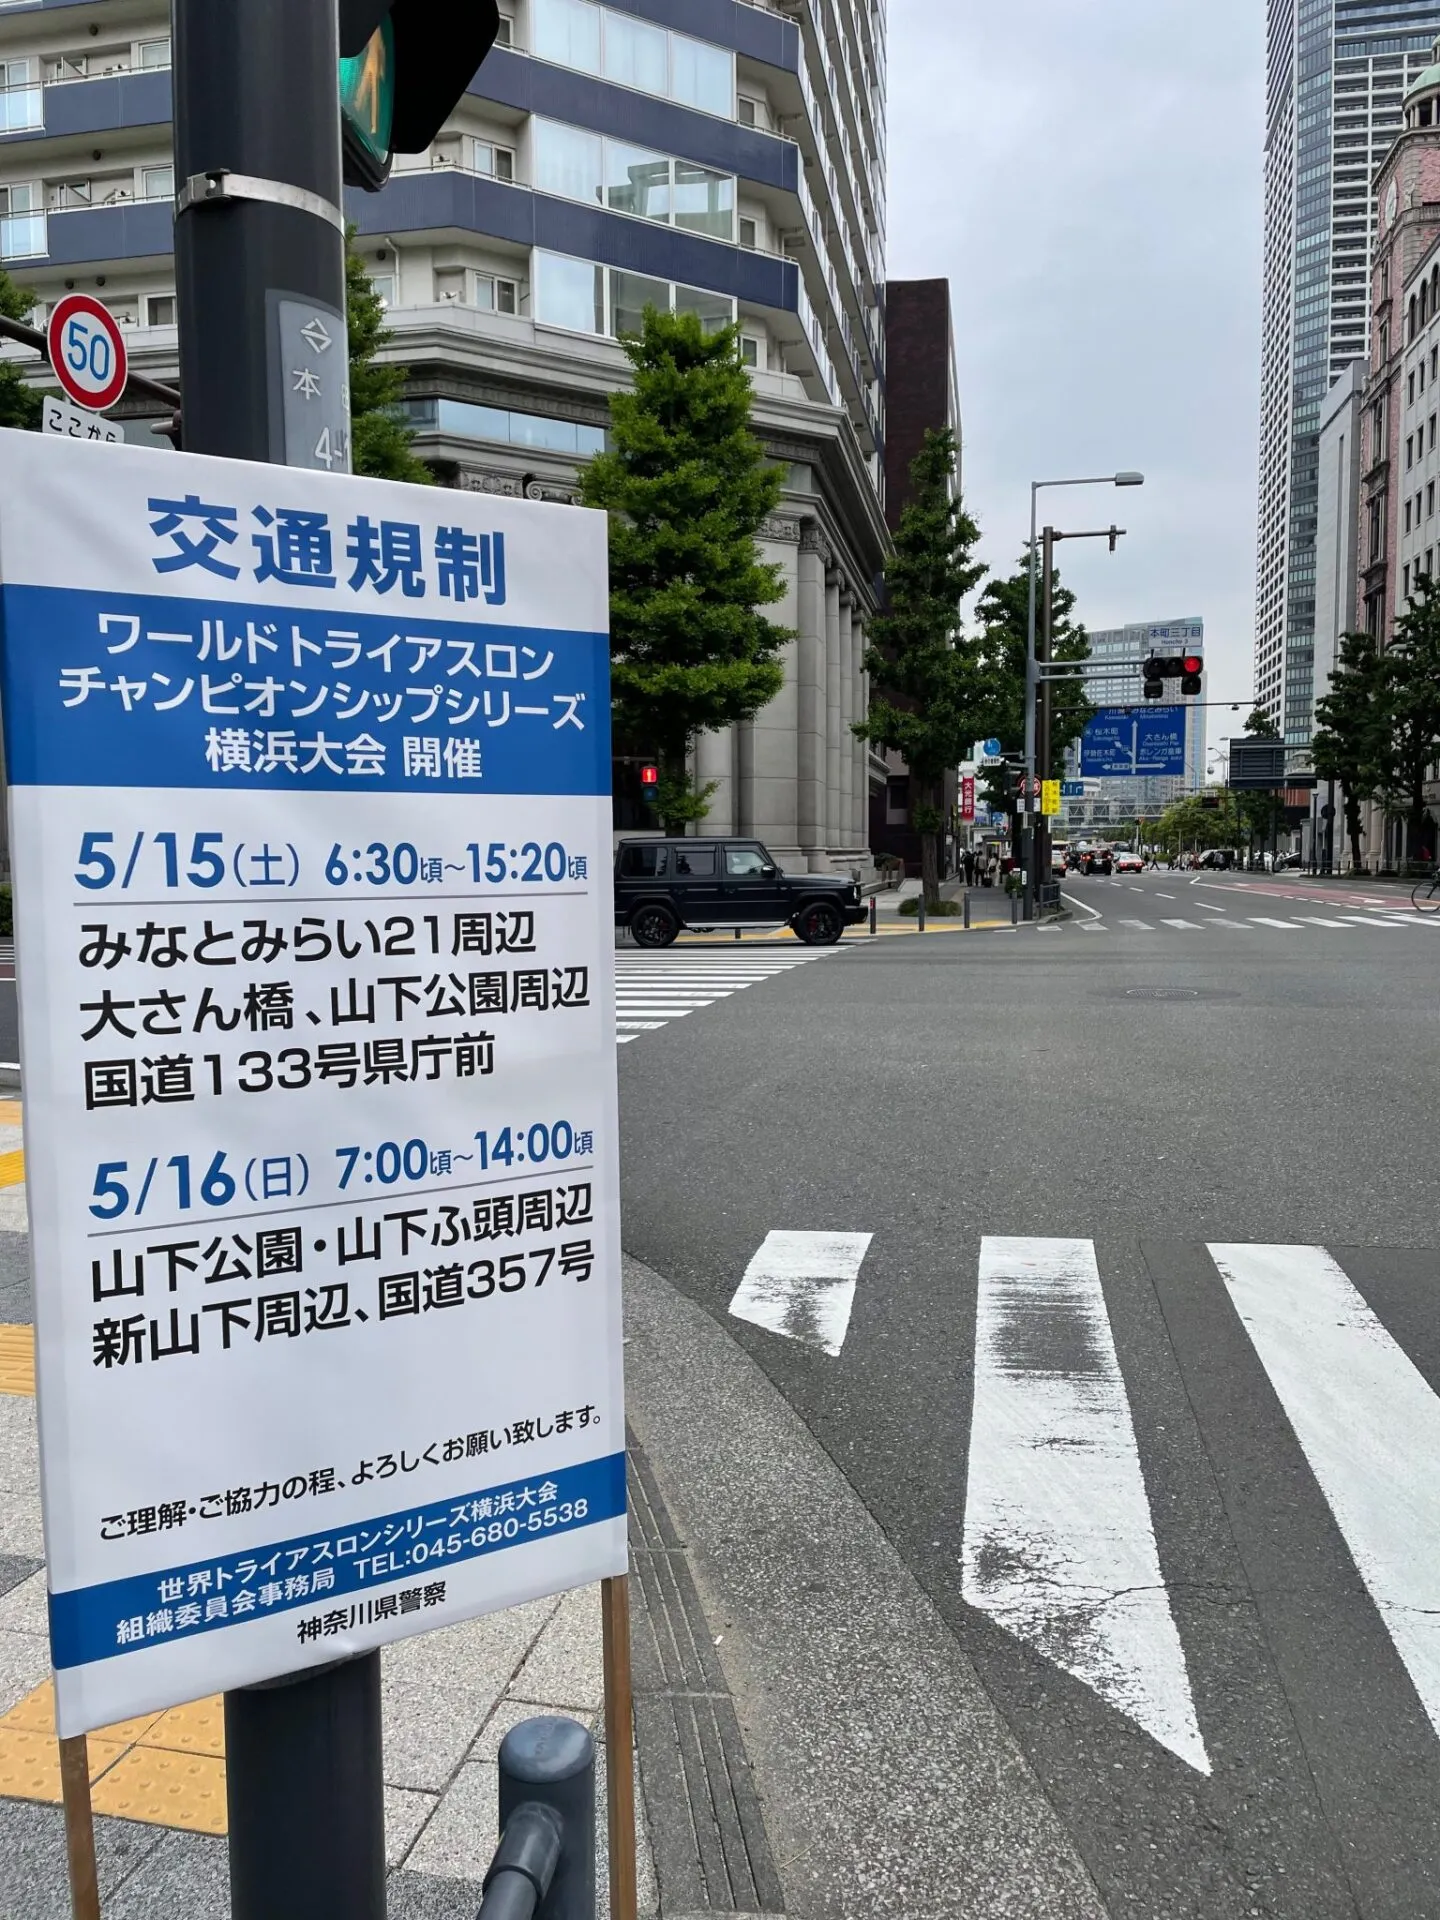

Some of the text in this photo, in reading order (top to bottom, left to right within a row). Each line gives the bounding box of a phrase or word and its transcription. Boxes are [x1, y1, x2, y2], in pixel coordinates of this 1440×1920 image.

[67, 320, 110, 382] 50
[293, 368, 322, 400] 本
[147, 494, 508, 606] 交通規制
[98, 613, 555, 681] ワールドトライアスロン
[1149, 626, 1201, 639] 本町三丁目
[58, 665, 587, 731] チャンピオンシップシリーズ
[205, 728, 483, 779] 横浜大会 開催
[74, 831, 300, 890] 5/15(土)
[78, 910, 537, 971] みなとみらい21周辺
[79, 966, 591, 1043] 大さん橋、山下公園周辺
[83, 1030, 497, 1111] 国道133号県庁前
[87, 1150, 310, 1220] 5/16(日)
[91, 1182, 594, 1303] 山下公園・山下ふ頭周辺
[92, 1239, 596, 1370] 新山下周辺、国道357号
[99, 1404, 602, 1542] ご理解・ご協力の程、よろしくお願い致します。
[115, 1498, 589, 1645] 組織委員会事務局 TEL:045-680-5538
[156, 1481, 559, 1603] 世界トライアスロンシリーズ横浜大会
[296, 1581, 448, 1645] 神奈川県警察
